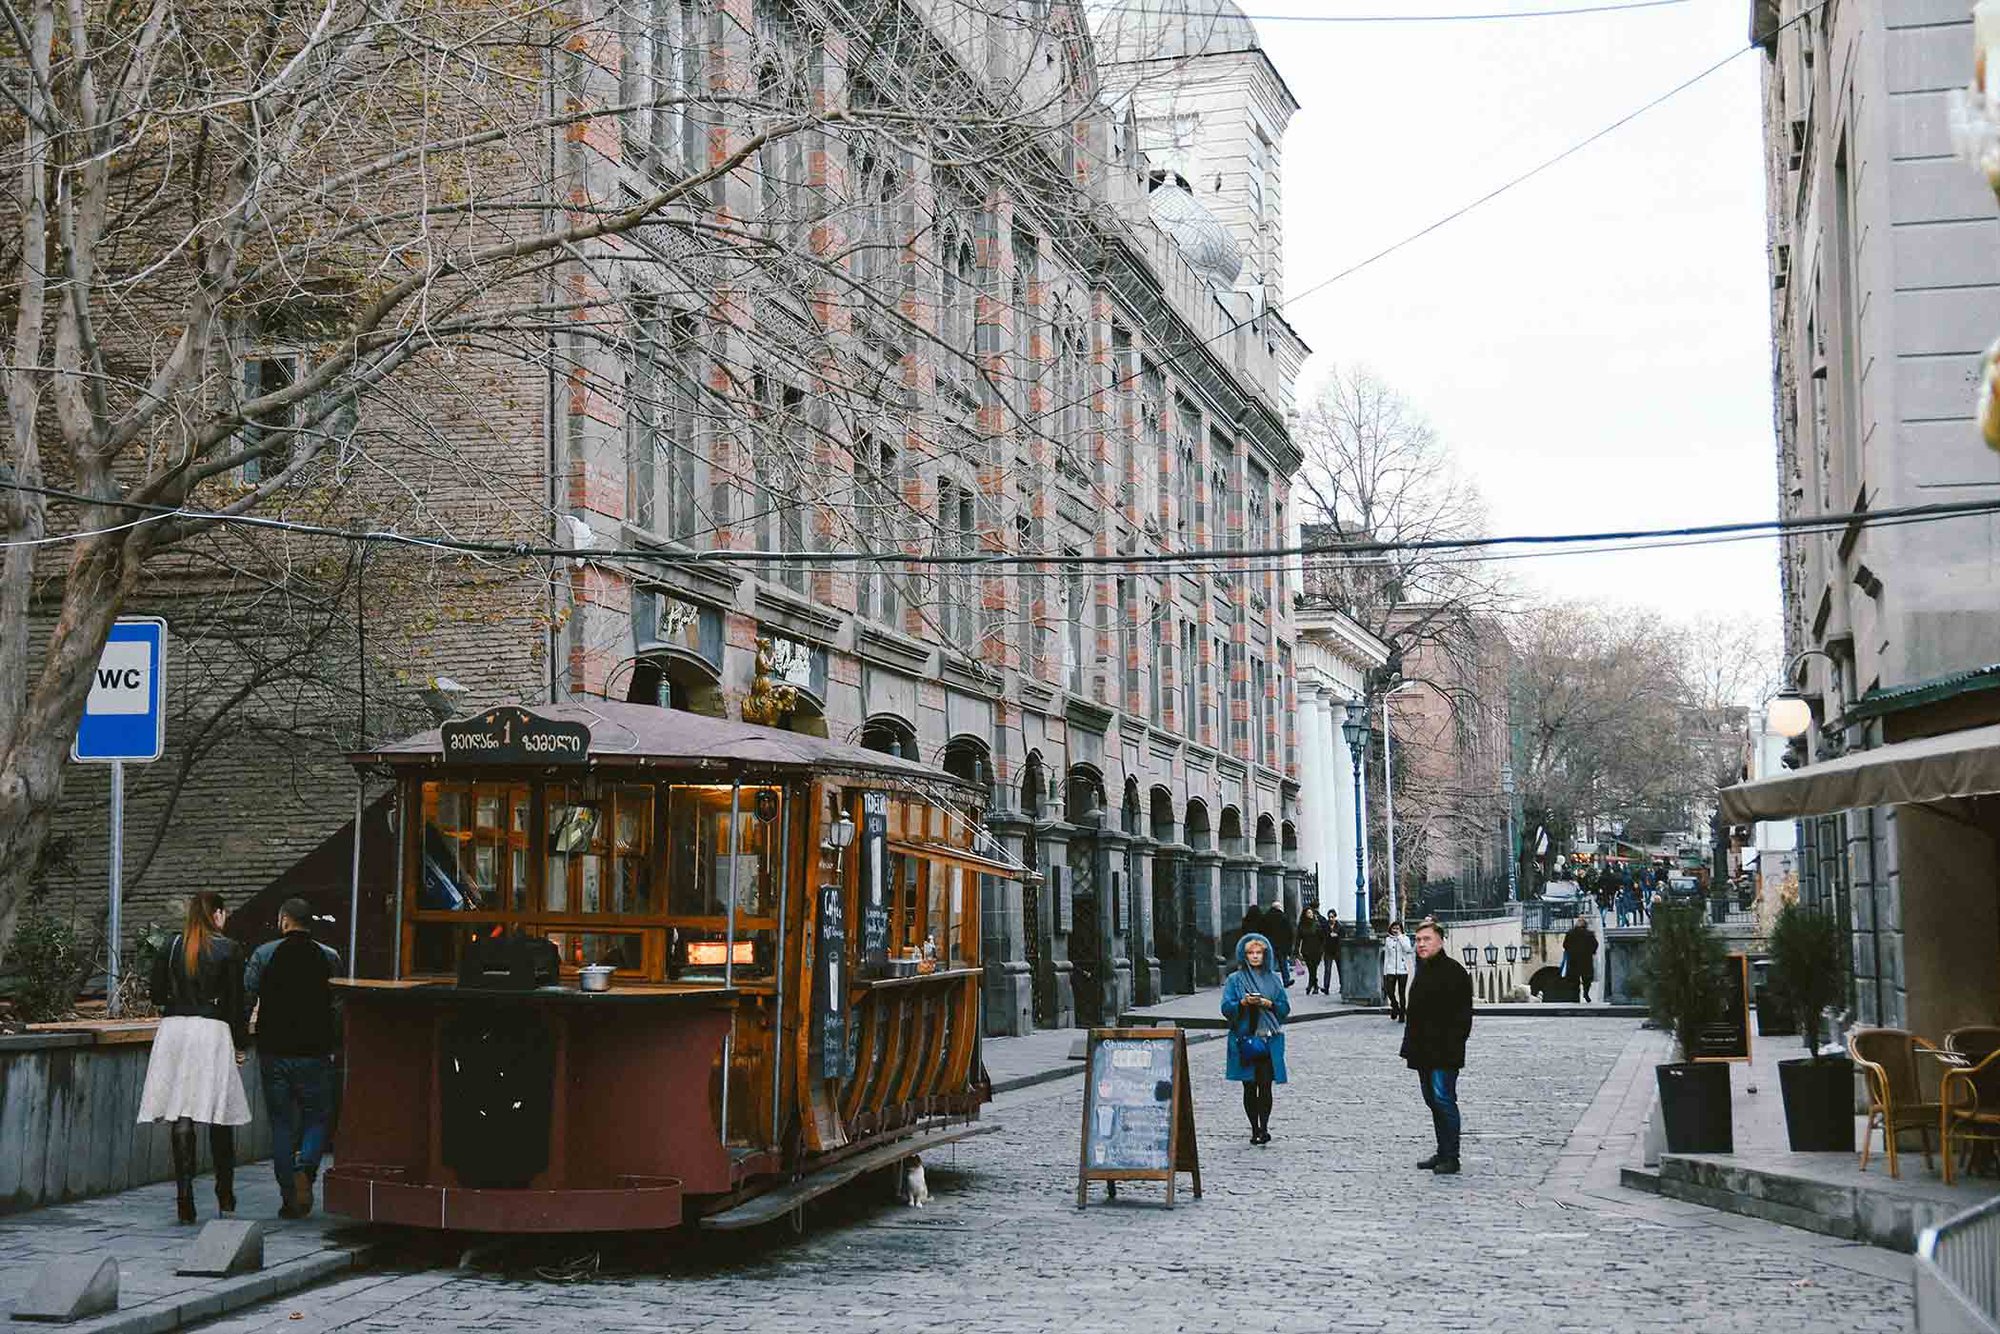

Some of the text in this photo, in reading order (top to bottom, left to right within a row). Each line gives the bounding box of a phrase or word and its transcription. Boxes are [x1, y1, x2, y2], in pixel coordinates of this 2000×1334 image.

[98, 669, 140, 689] WC
[503, 720, 511, 744] 1
[522, 735, 580, 752] ზემელი
